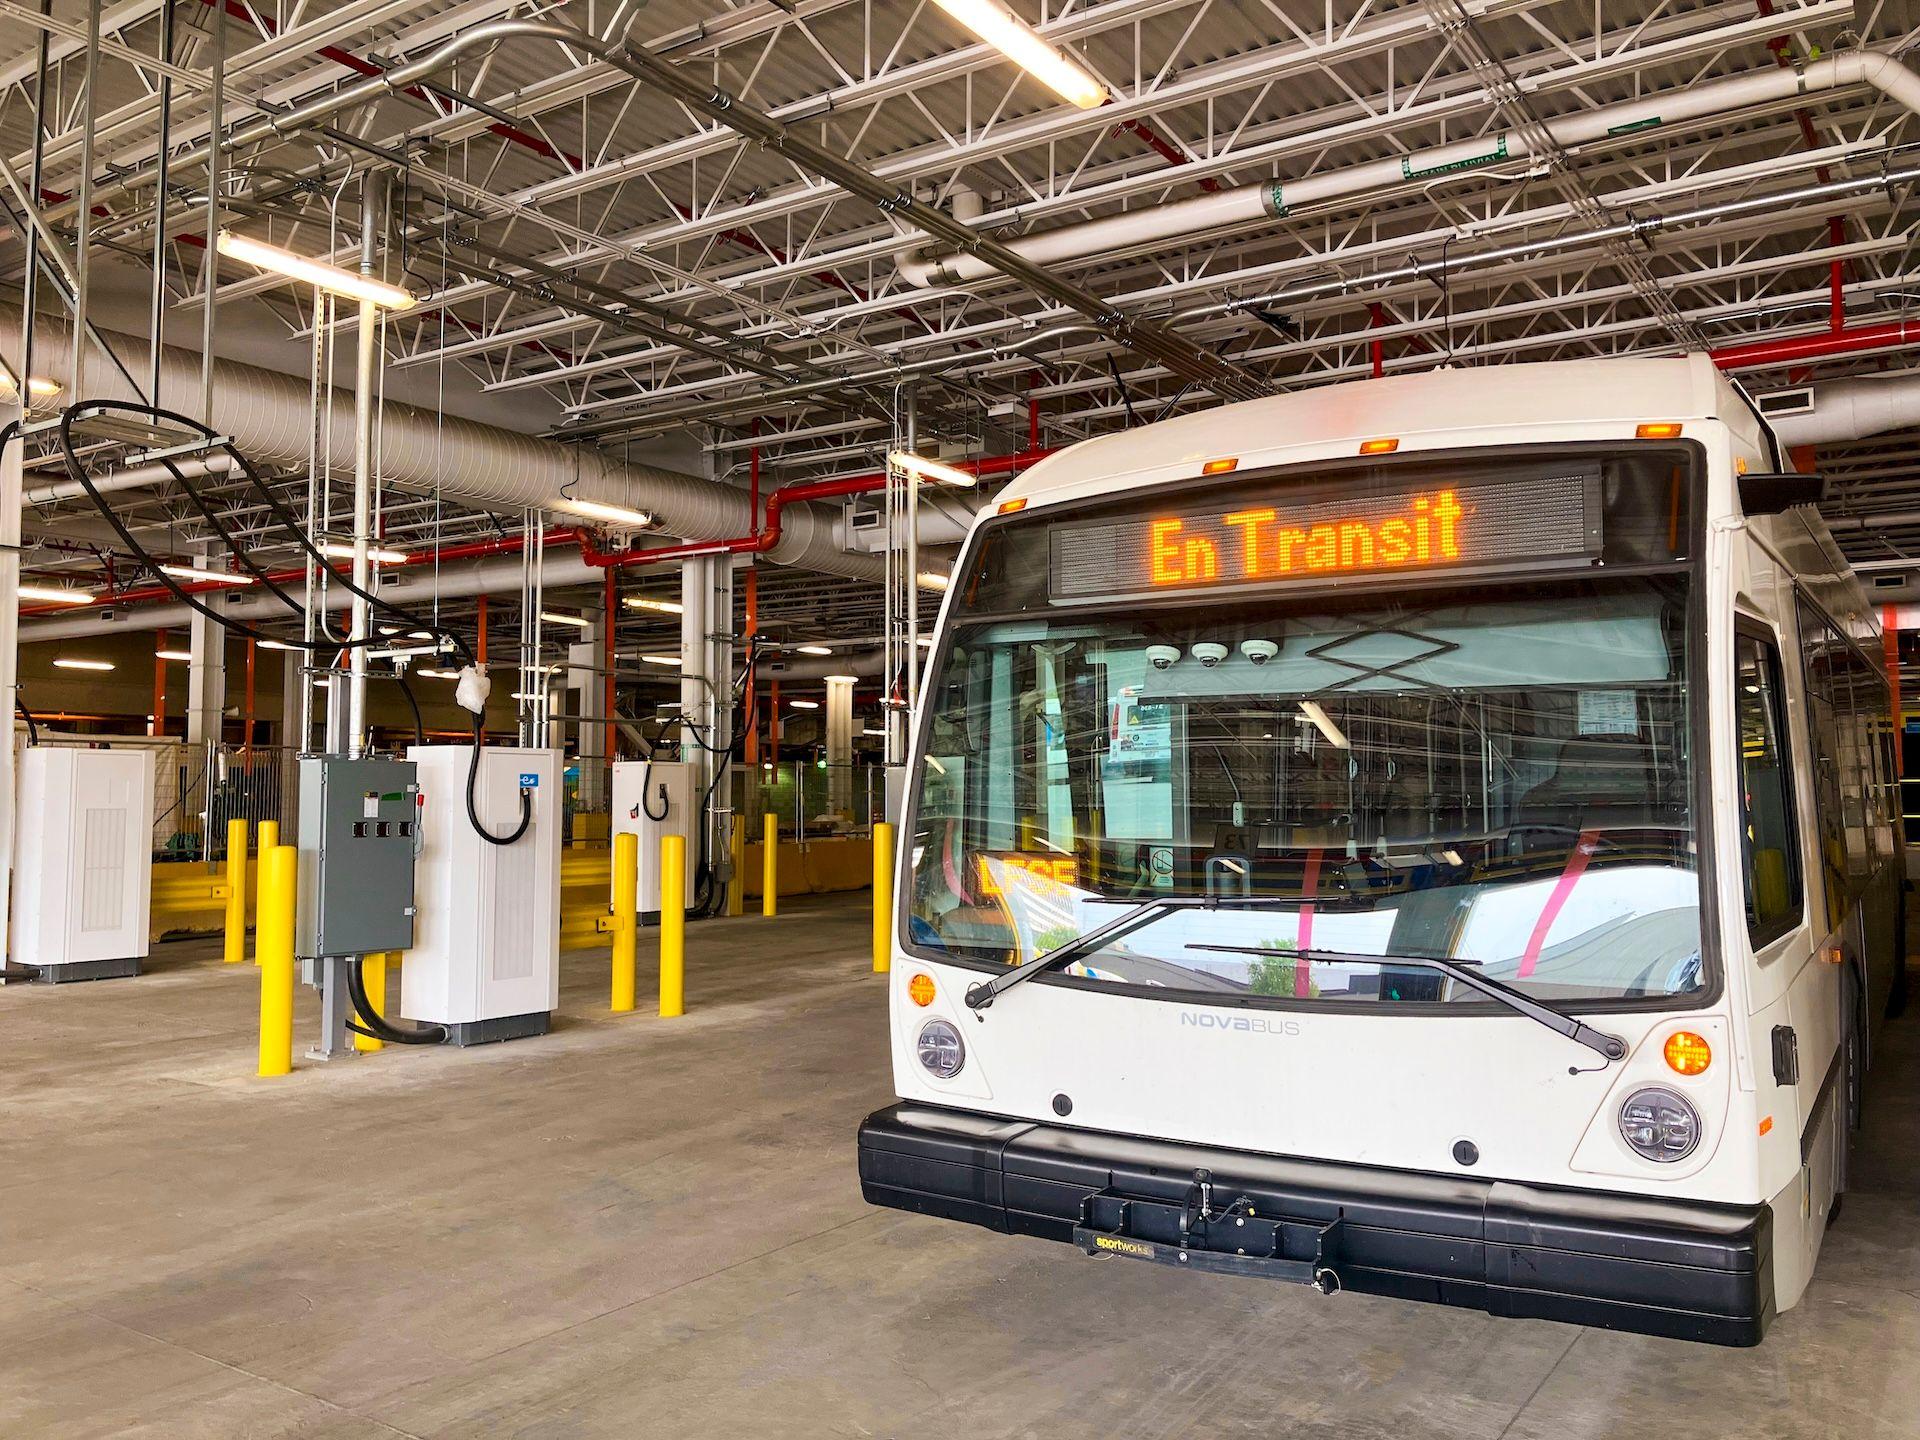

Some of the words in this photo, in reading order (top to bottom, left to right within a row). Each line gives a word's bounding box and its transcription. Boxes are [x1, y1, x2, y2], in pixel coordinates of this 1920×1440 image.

[1151, 518, 1218, 584] En
[1226, 490, 1464, 576] Transit
[1096, 1237, 1149, 1255] sportworks
